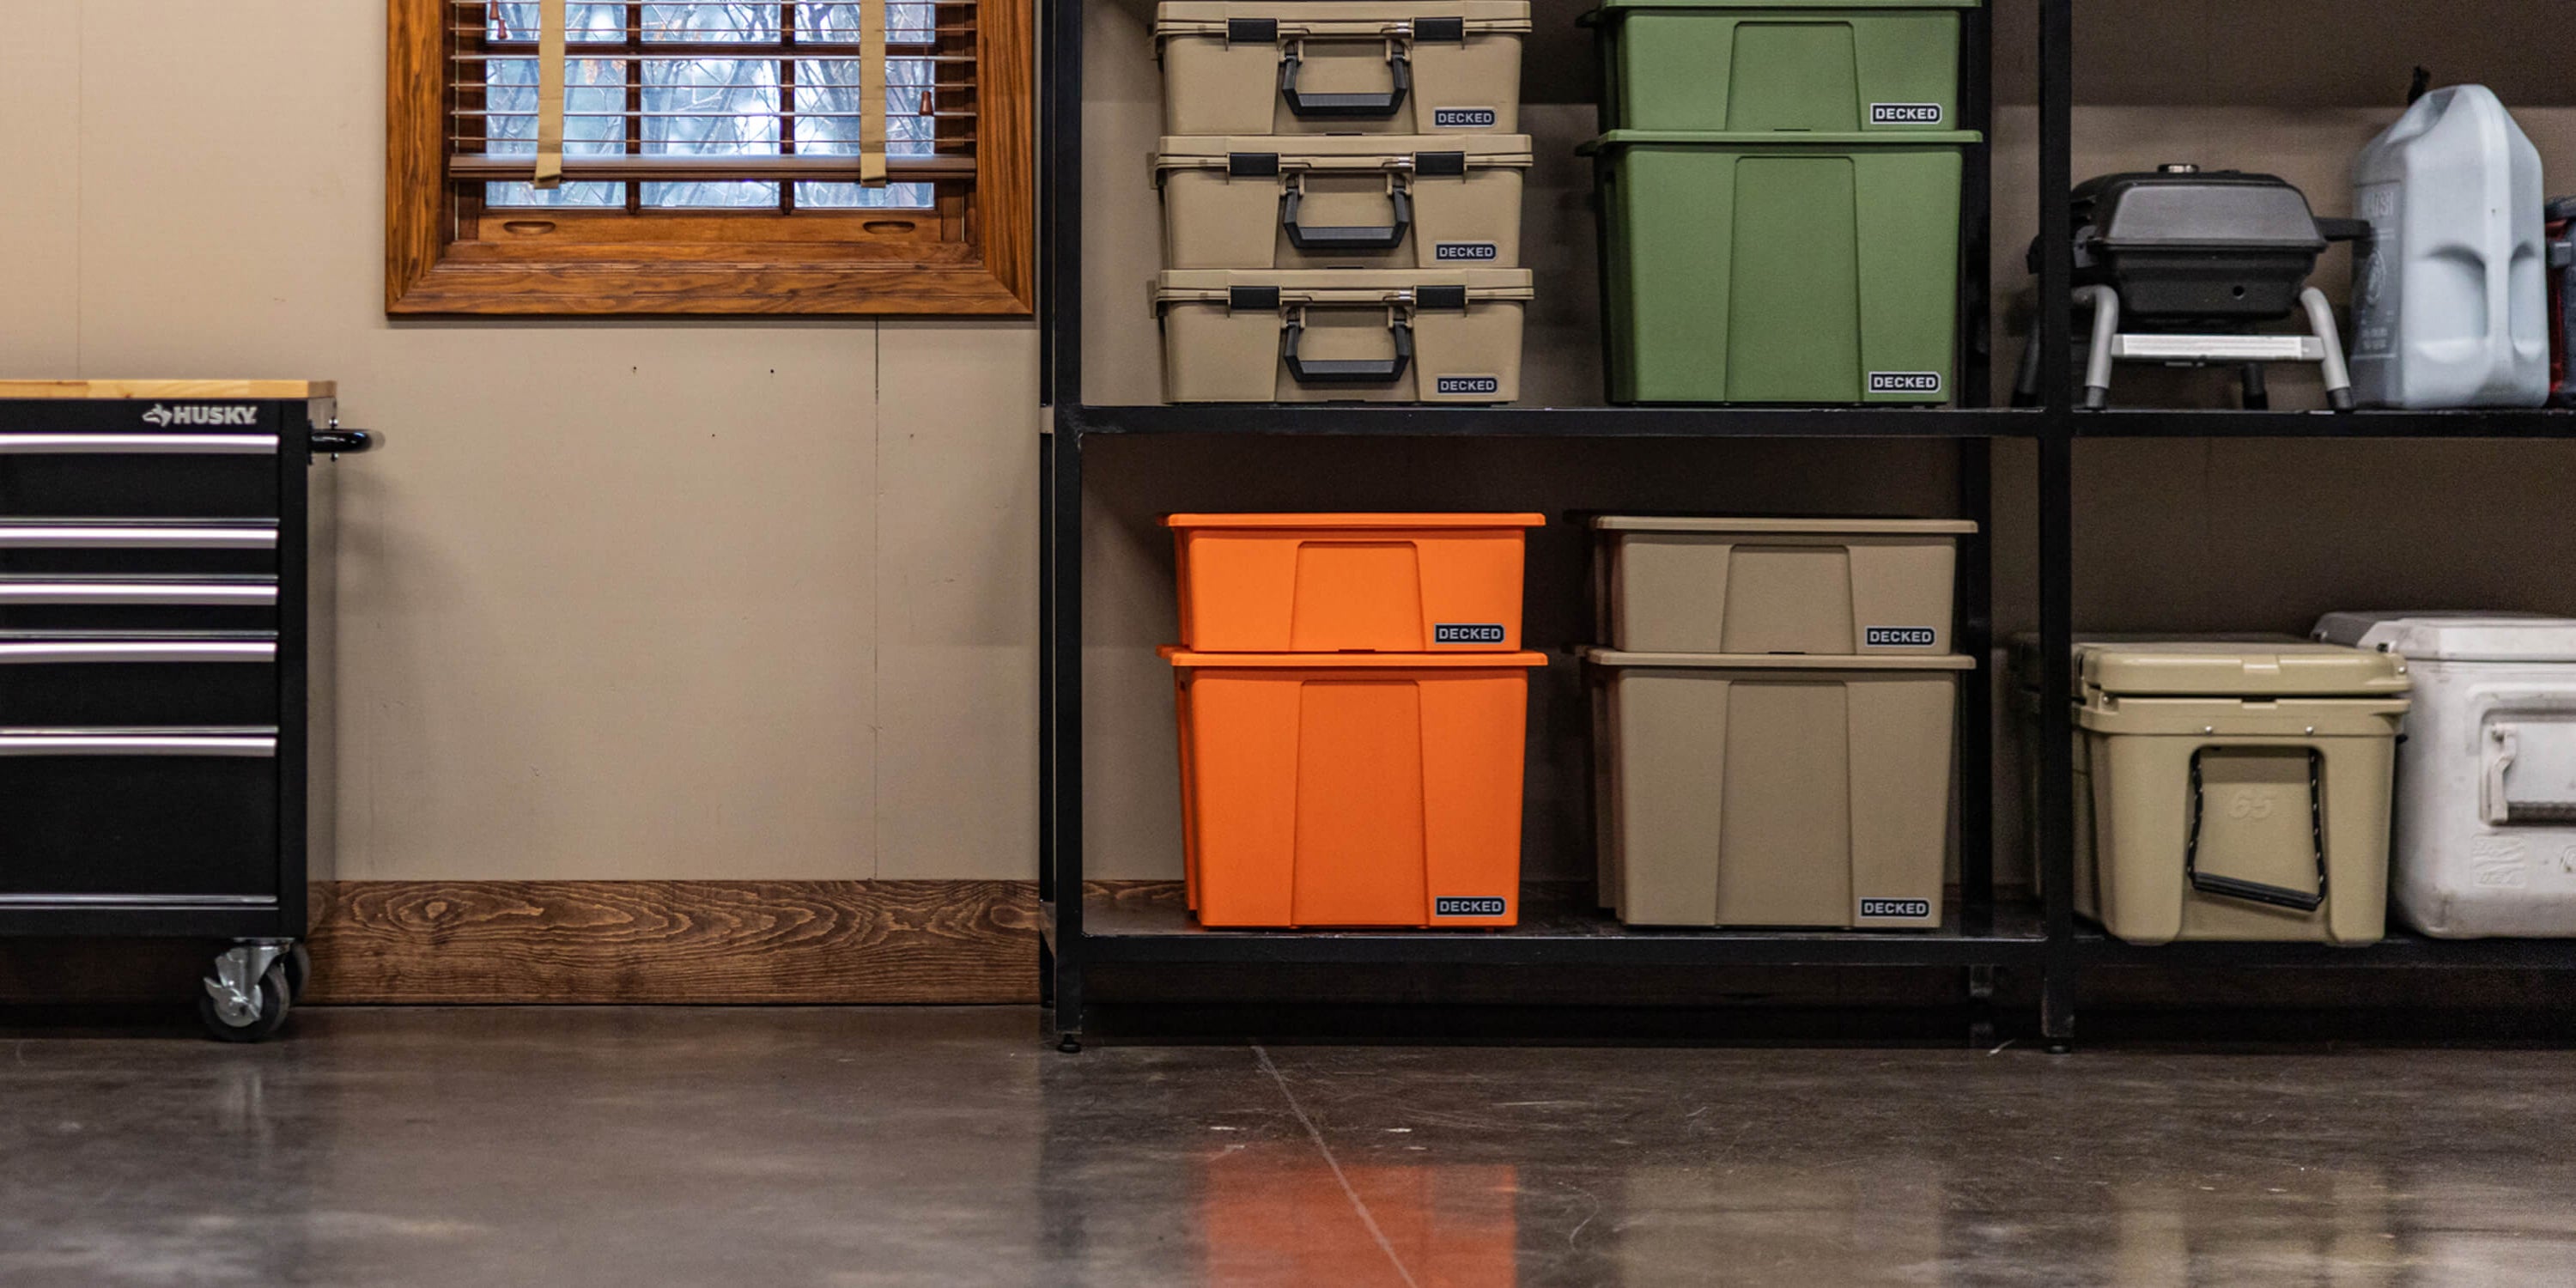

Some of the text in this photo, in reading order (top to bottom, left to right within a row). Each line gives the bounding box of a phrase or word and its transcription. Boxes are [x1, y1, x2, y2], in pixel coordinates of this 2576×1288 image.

[1437, 112, 1493, 124] DECKED
[1874, 107, 1938, 120] DECKED
[1438, 246, 1494, 258] DECKED
[1439, 380, 1495, 392] DECKED
[1873, 376, 1936, 388] DECKED
[173, 405, 258, 425] HUSKY
[1437, 628, 1502, 640] DECKED
[1869, 630, 1932, 643] DECKED
[1438, 901, 1503, 913] DECKED
[1863, 902, 1927, 914] DECKED
